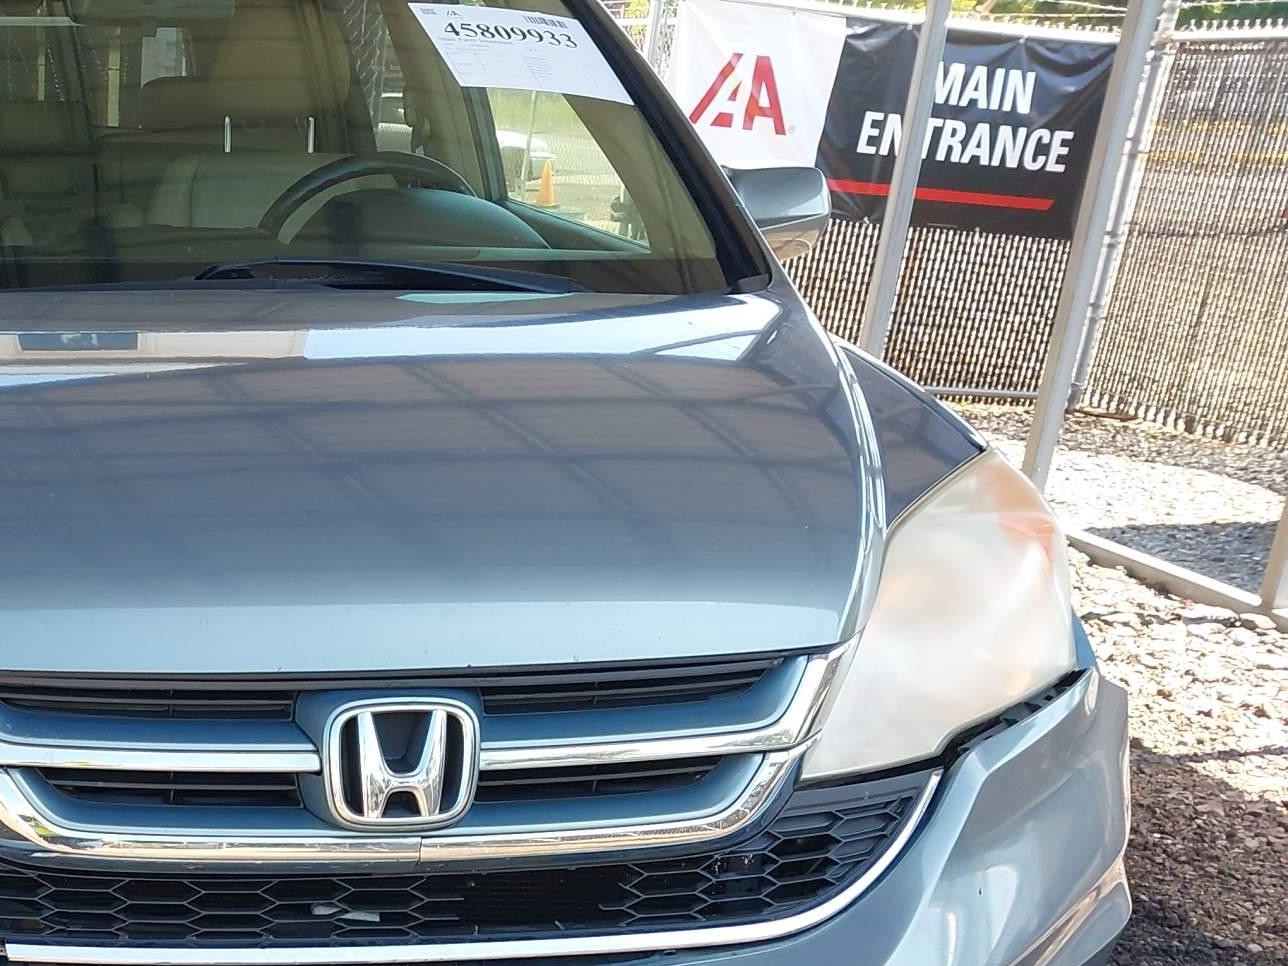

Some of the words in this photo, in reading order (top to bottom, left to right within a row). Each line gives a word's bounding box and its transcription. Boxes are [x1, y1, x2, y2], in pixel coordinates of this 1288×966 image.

[444, 22, 578, 49] 45809933
[935, 60, 1036, 115] MAIN
[856, 111, 1074, 173] ENTRANCE
